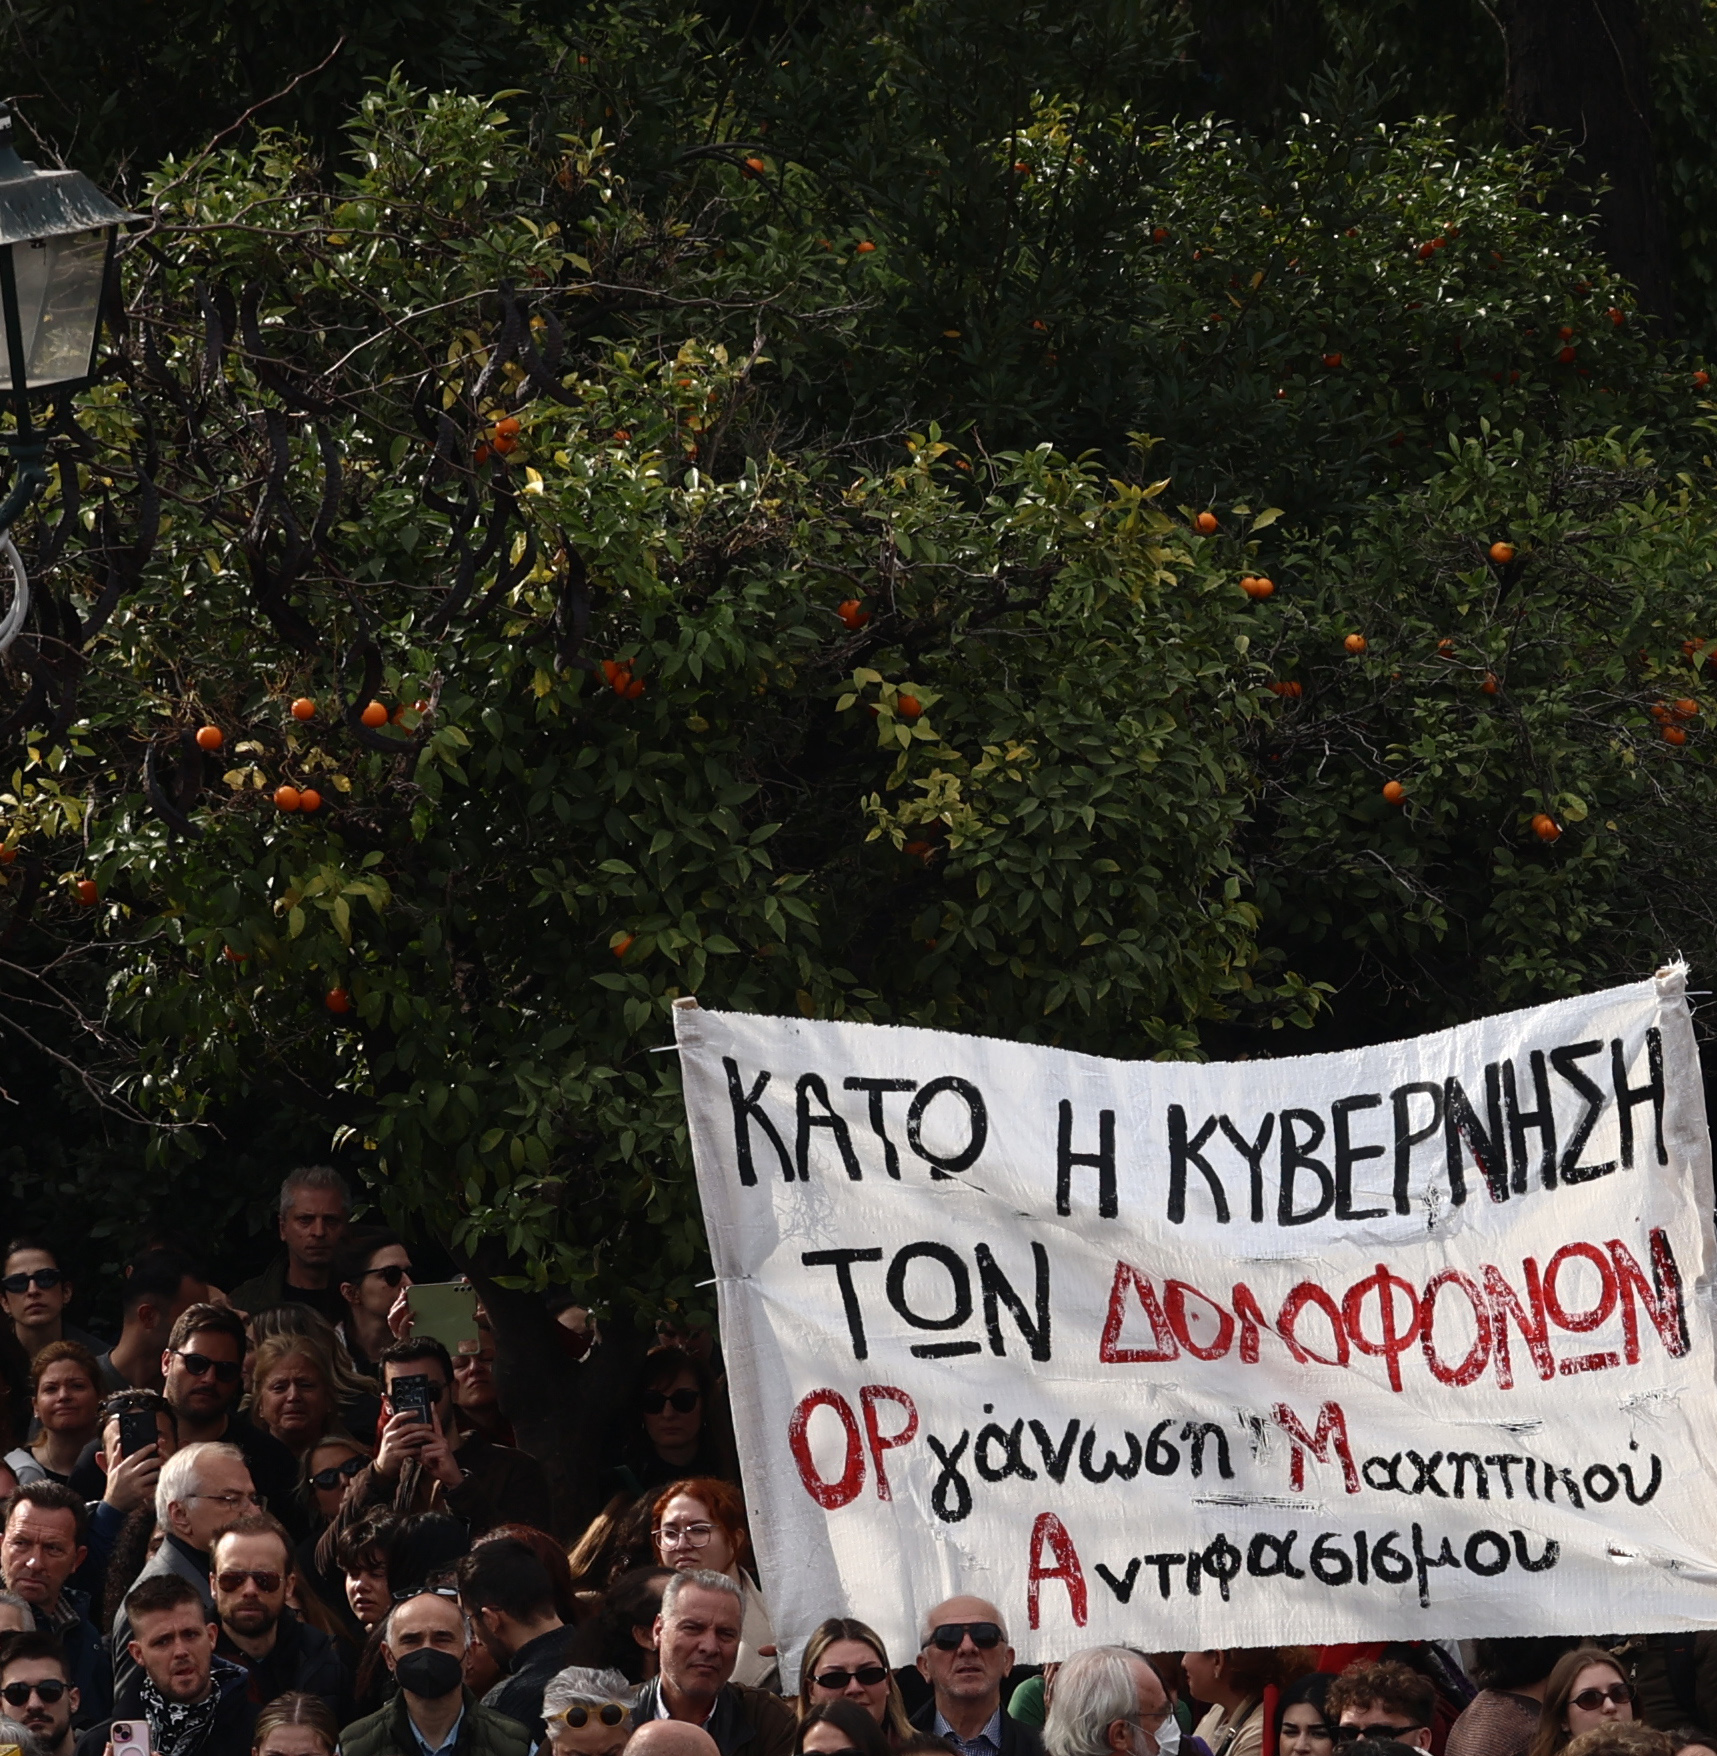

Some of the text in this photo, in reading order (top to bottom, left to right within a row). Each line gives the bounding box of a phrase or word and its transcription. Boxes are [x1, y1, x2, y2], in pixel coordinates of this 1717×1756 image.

[1056, 1098, 1119, 1219] Η
[1167, 1026, 1669, 1227] ΚΥΒΕΡΝΗΣΗ
[801, 1241, 1052, 1362] ΤΩΝ
